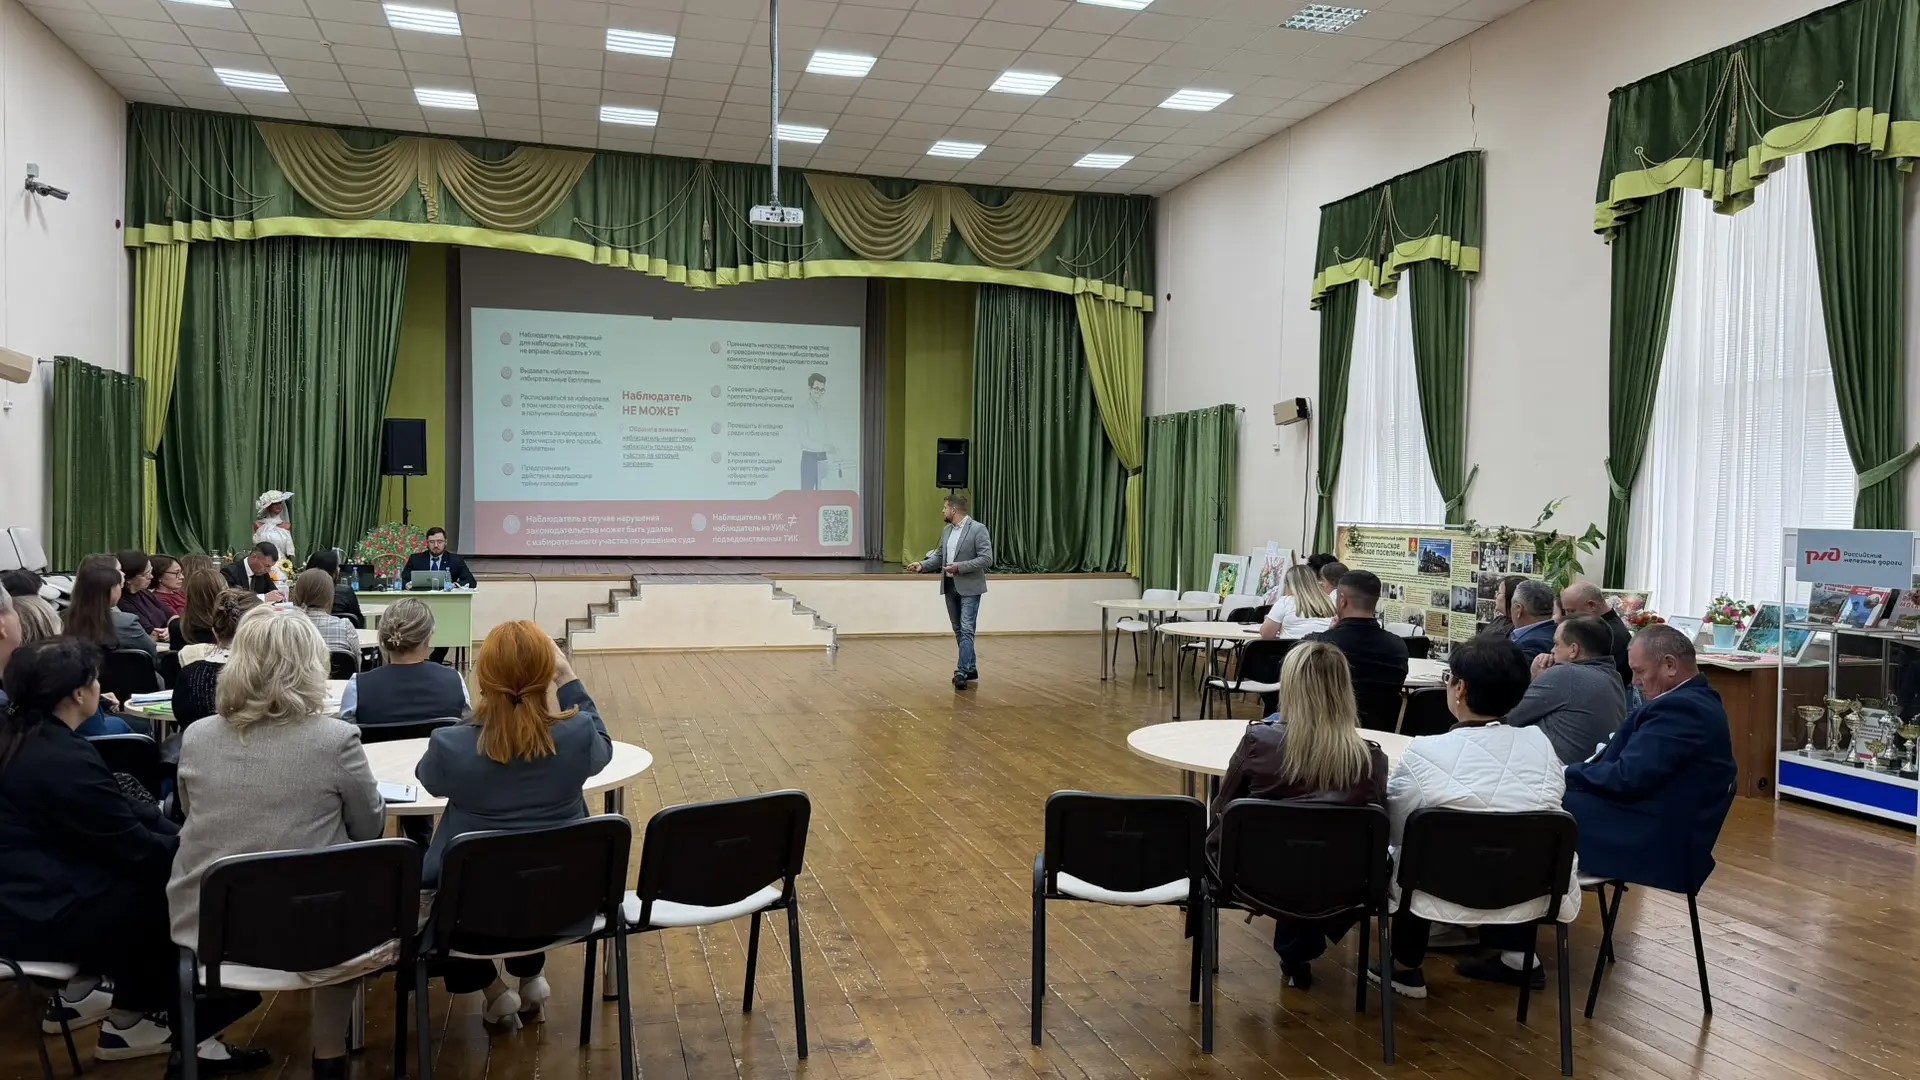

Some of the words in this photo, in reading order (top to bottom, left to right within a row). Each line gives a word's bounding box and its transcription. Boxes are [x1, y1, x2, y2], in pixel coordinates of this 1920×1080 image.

[622, 390, 692, 402] Наблюдатель
[622, 406, 636, 415] НЕ
[639, 406, 680, 416] МОЖЕТ
[526, 515, 582, 524] Наблюдатель
[588, 516, 615, 524] случае
[617, 515, 660, 524] нарушения
[712, 514, 762, 522] Наблюдатель
[526, 527, 599, 536] законодательства
[647, 526, 673, 534] удален
[712, 524, 760, 533] наблюдатель
[532, 538, 596, 547] избирательного
[599, 538, 629, 547] участка
[641, 537, 677, 545] решению
[678, 537, 696, 545] суда
[1357, 541, 1400, 549] руглопольское
[1376, 549, 1406, 557] поселение
